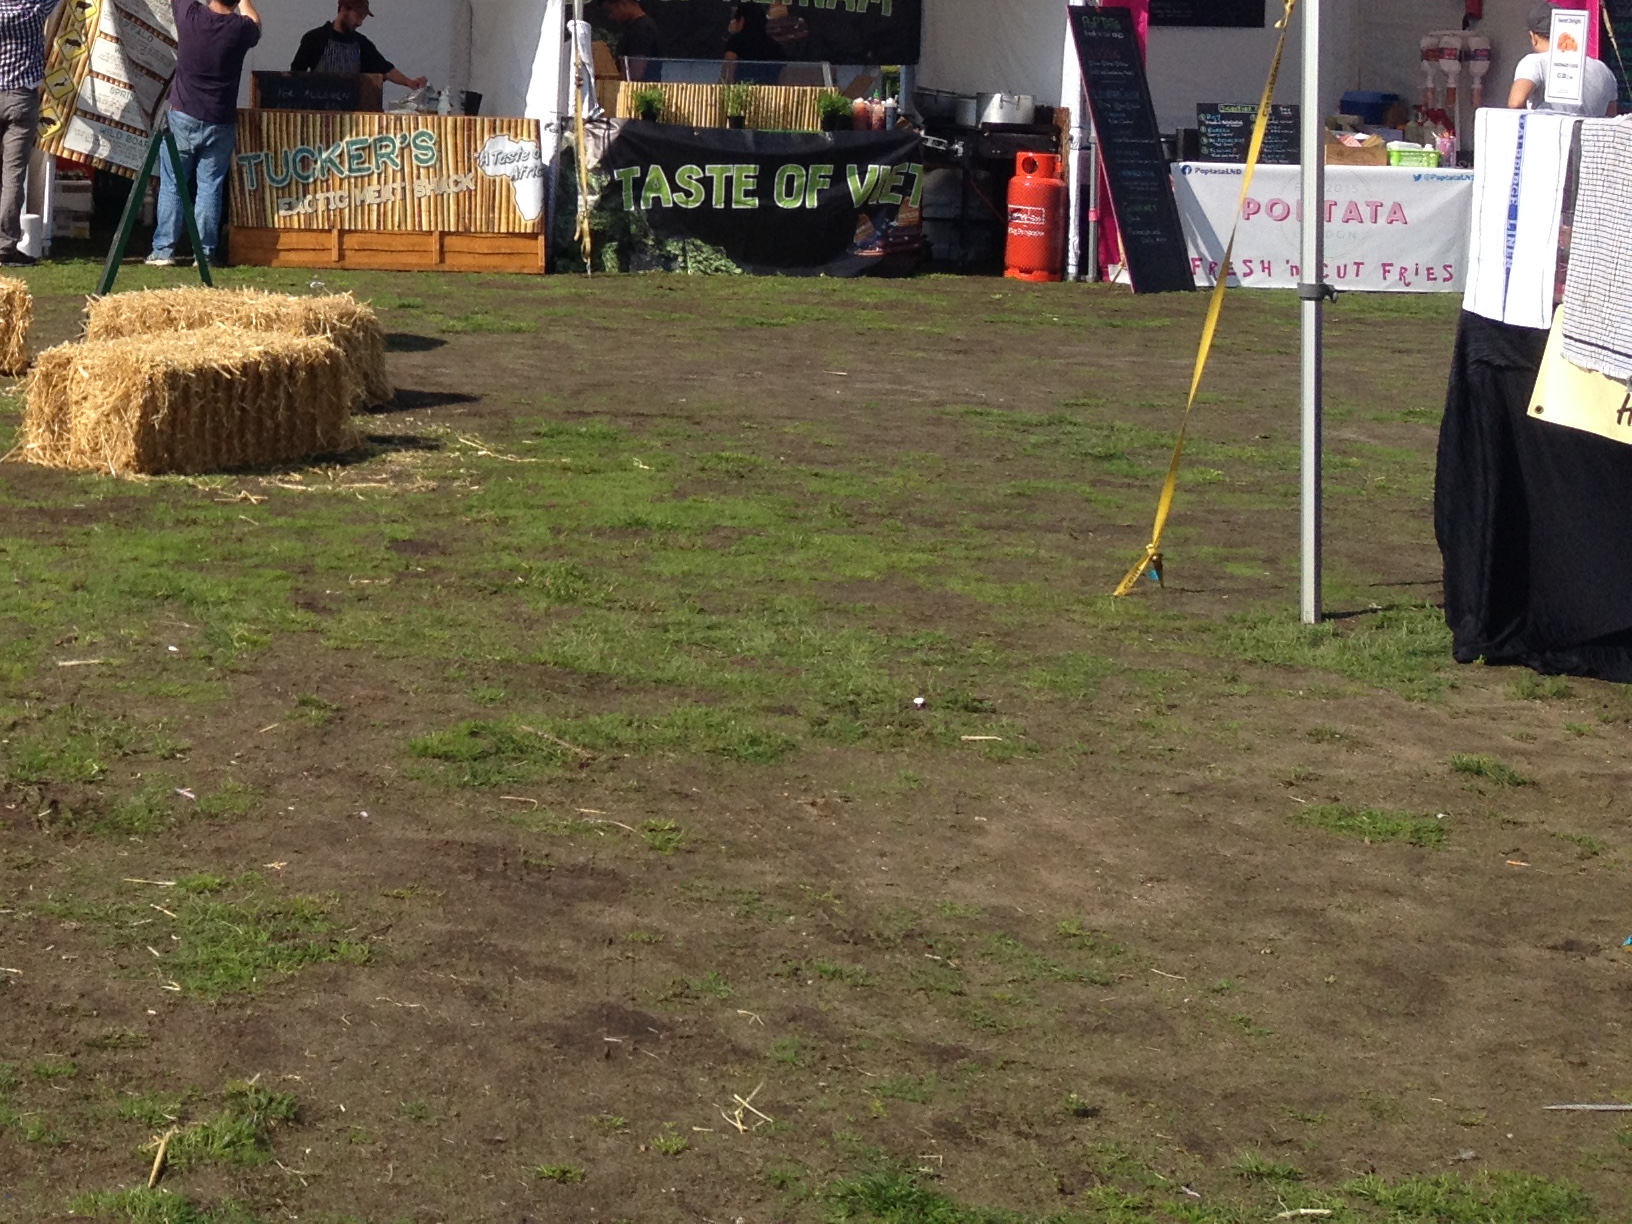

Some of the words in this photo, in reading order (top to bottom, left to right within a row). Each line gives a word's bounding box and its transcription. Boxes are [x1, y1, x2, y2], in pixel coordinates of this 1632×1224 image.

[237, 129, 438, 190] TUCKER'S
[491, 147, 531, 166] Taste
[510, 164, 545, 183] Afric
[278, 190, 349, 217] EXOTIC
[355, 182, 407, 206] MEAT
[414, 173, 476, 199] SHACK
[614, 163, 760, 211] TASTE
[773, 164, 834, 209] OF
